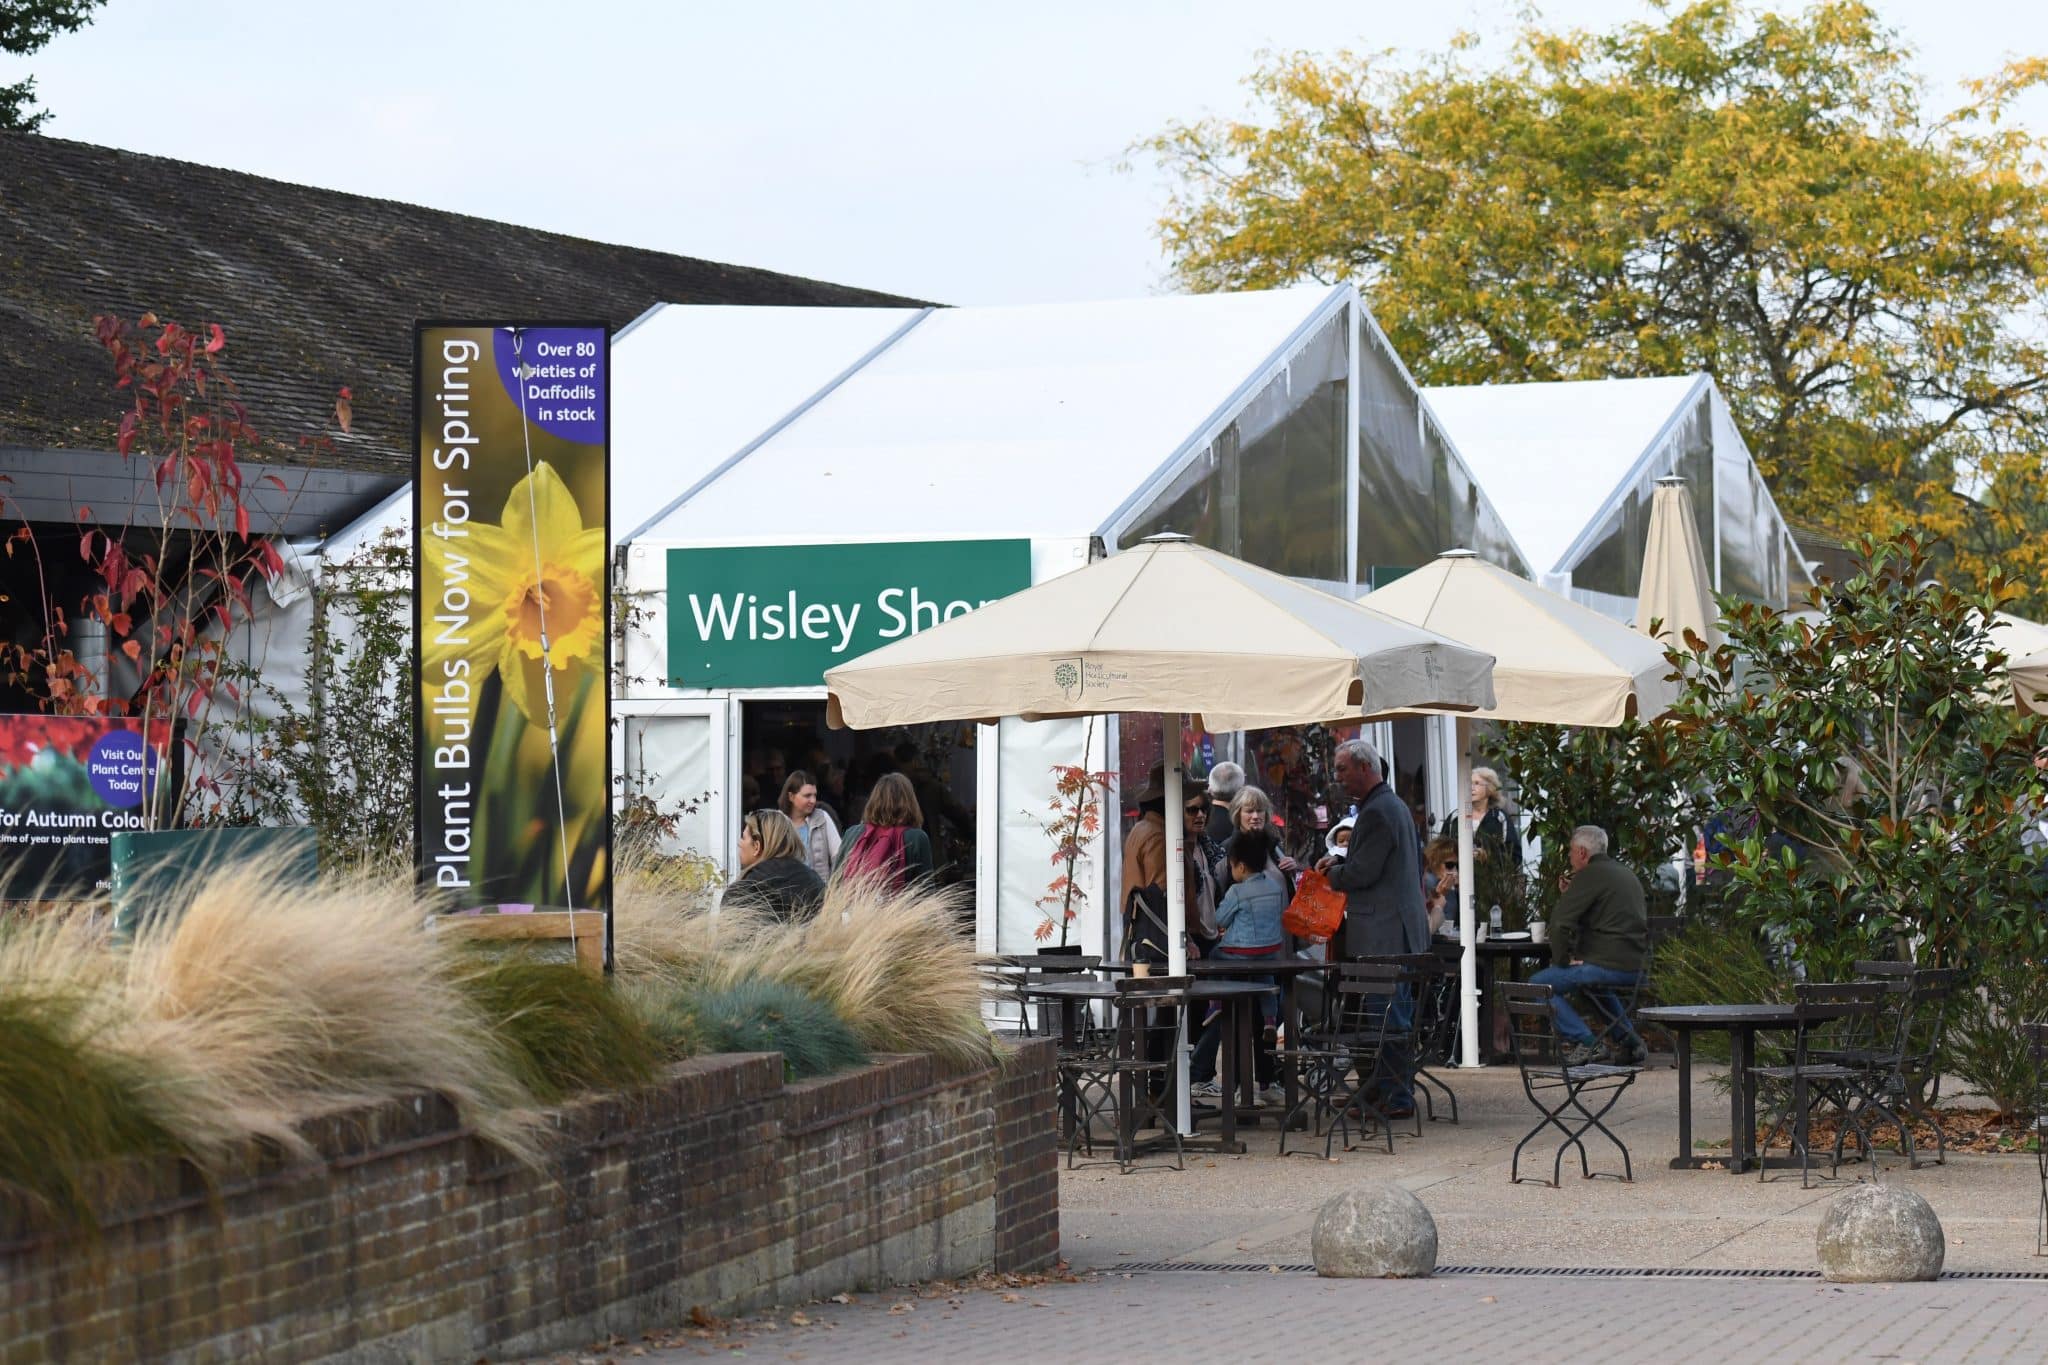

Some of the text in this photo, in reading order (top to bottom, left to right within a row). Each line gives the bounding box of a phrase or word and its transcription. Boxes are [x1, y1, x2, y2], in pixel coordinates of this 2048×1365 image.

[537, 342, 596, 357] Over 80
[512, 363, 596, 378] vieties of
[528, 384, 596, 400] Daffodils
[538, 406, 596, 421] in stock
[432, 339, 480, 887] Plant Bulbs Now for Spring
[689, 586, 999, 653] Wisley Sh
[101, 749, 145, 761] Visit Ou
[92, 763, 155, 776] Plant Cente
[108, 778, 139, 792] Today
[26, 809, 97, 828] Autumn
[101, 810, 158, 829] Colou
[19, 833, 30, 843] of
[30, 835, 50, 846] year
[51, 834, 61, 844] to
[63, 835, 86, 847] plant
[87, 836, 109, 845] trees
